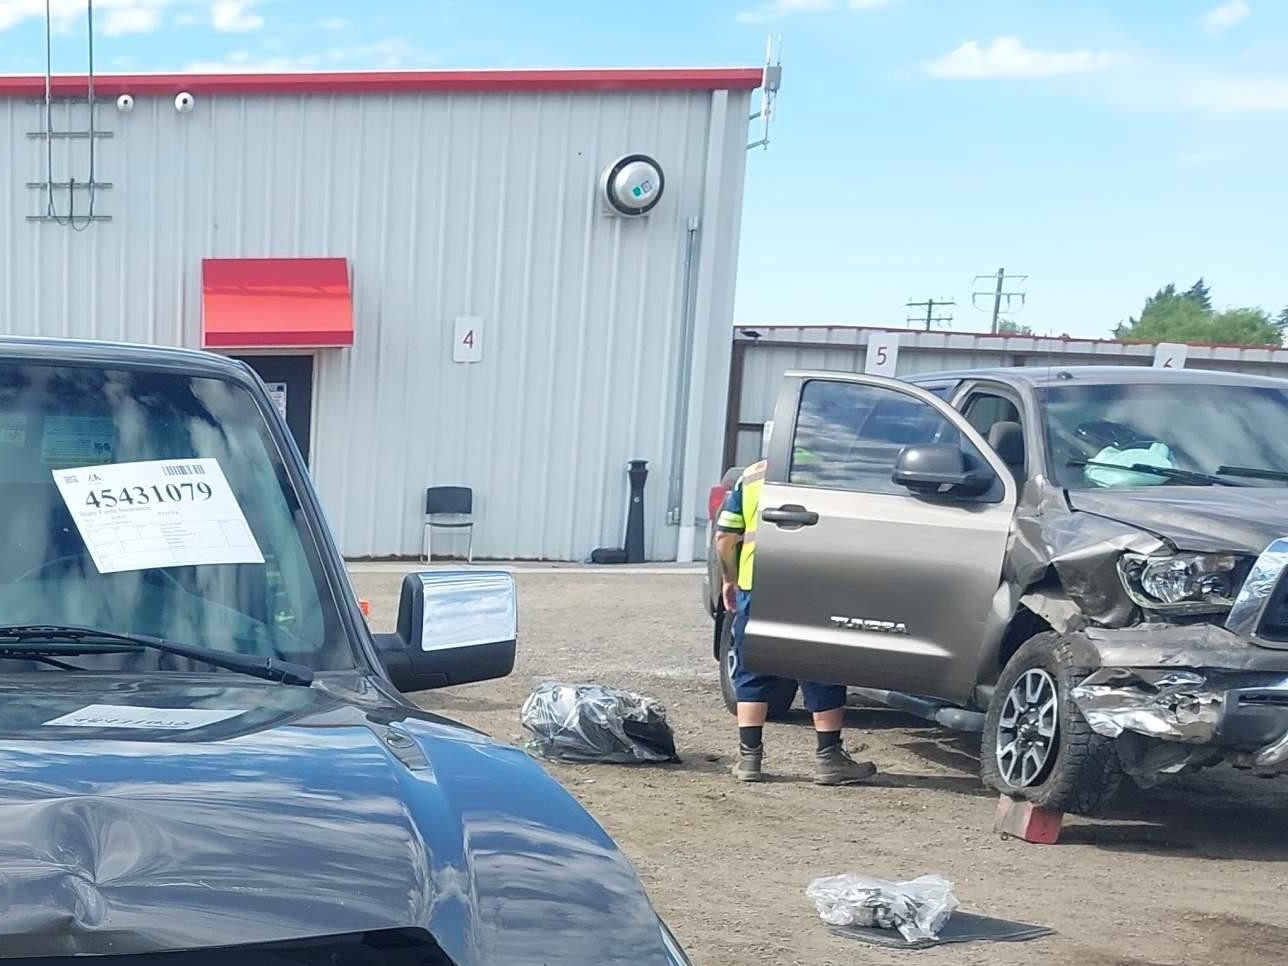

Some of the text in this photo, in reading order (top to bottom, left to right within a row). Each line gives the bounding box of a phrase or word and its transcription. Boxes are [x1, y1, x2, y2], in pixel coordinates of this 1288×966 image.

[462, 329, 474, 350] 4
[875, 346, 888, 366] 5
[85, 481, 213, 509] 45431079
